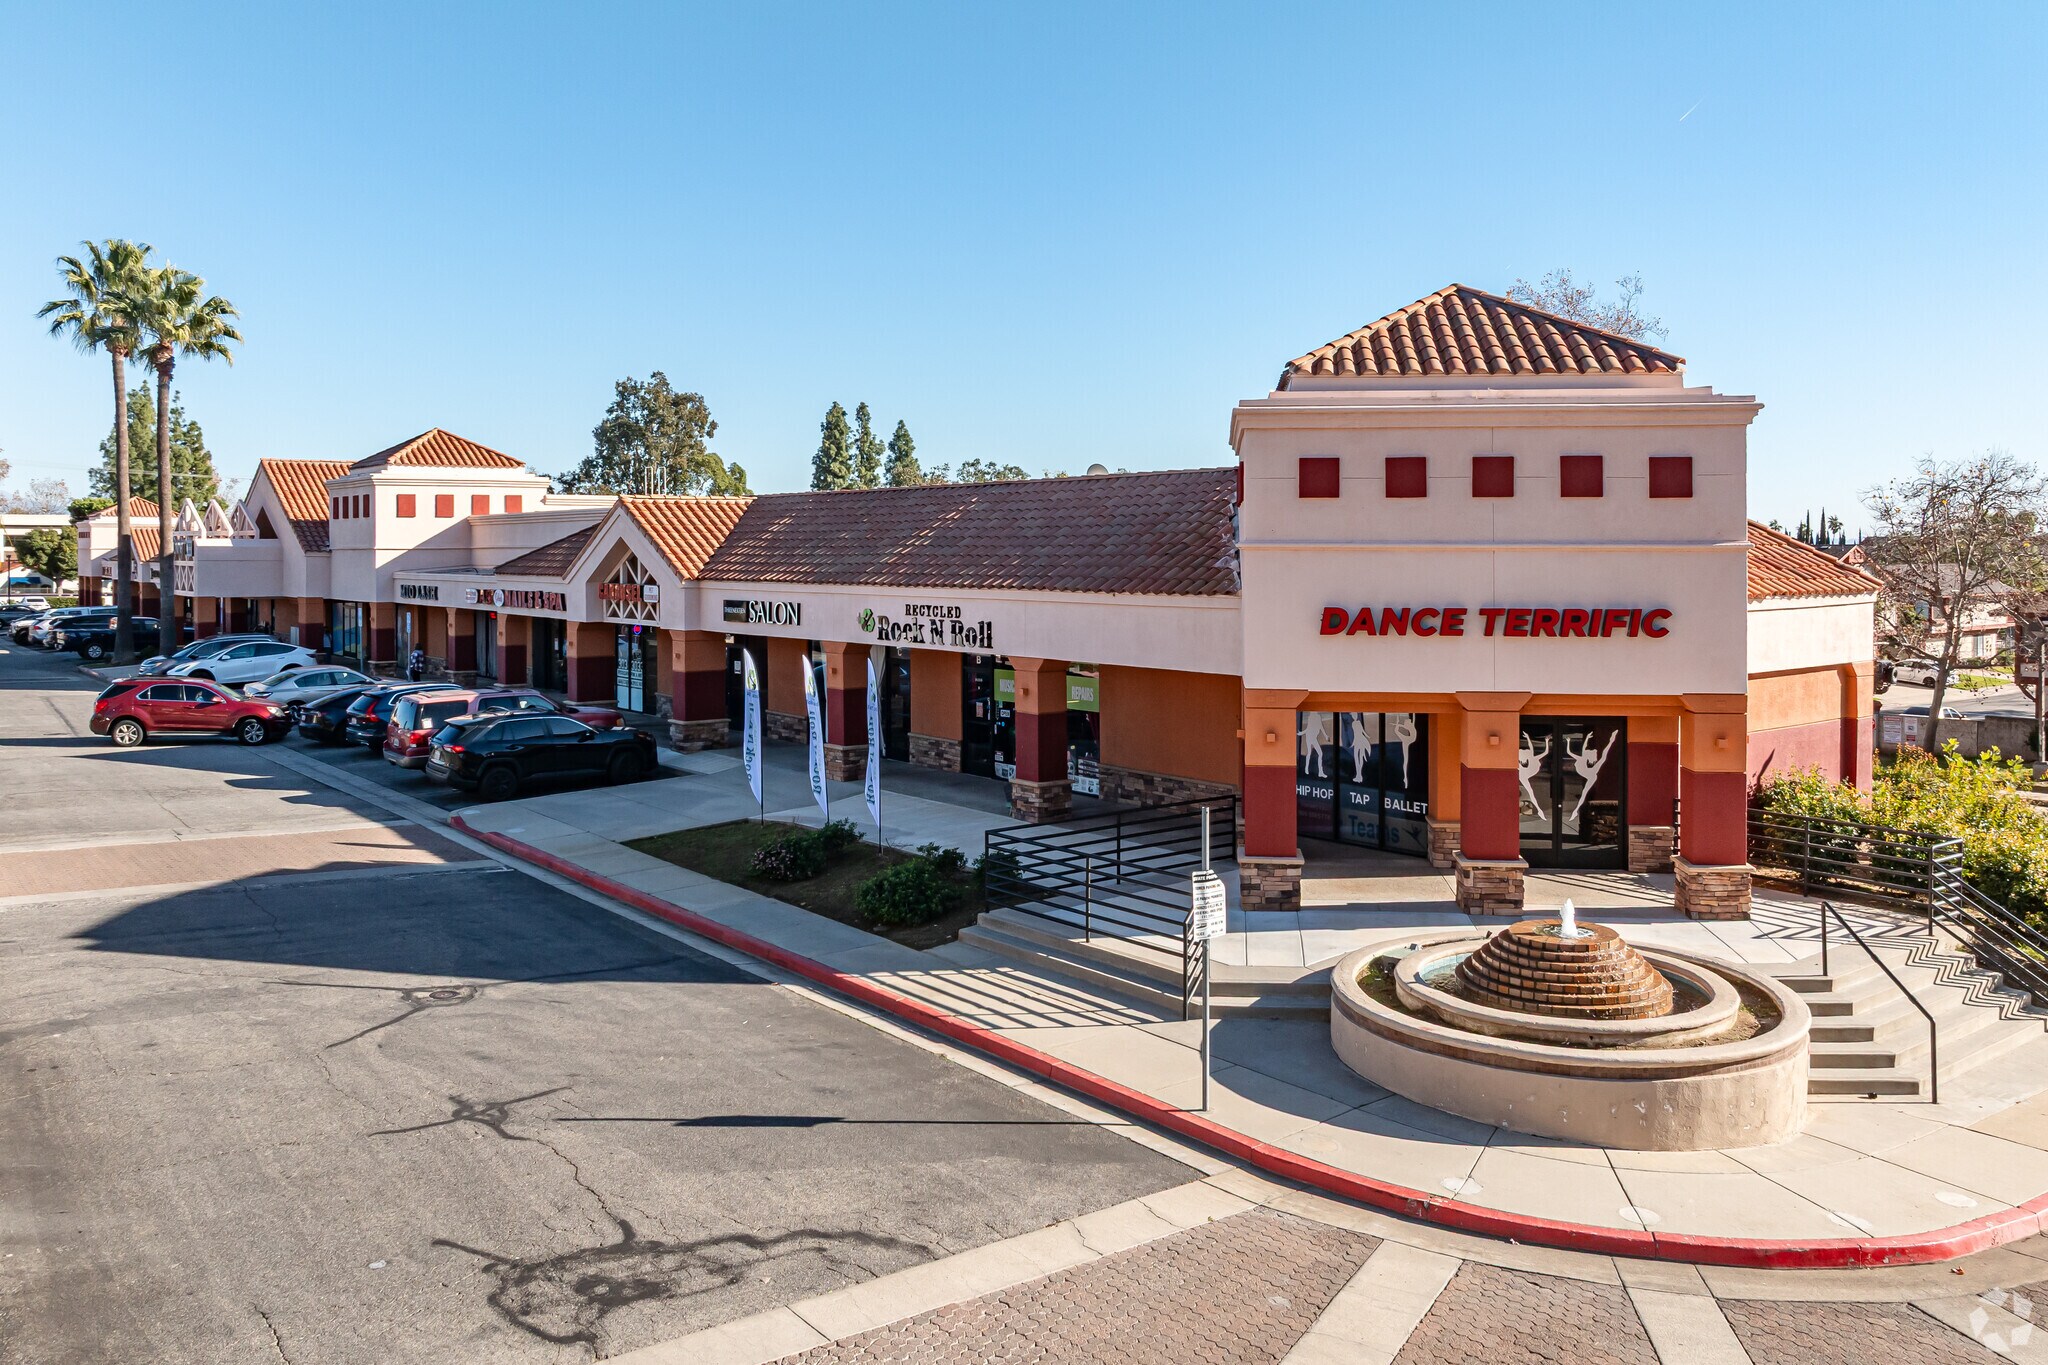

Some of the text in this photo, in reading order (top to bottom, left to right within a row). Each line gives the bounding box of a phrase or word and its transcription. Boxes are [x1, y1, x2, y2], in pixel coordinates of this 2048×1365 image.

[504, 590, 535, 608] NAILS
[543, 592, 564, 611] SPA
[748, 600, 800, 625] SALON
[905, 603, 961, 619] RECYCLED
[1320, 607, 1673, 638] DANCE TERRIFIC
[928, 618, 945, 646] N
[976, 655, 981, 664] B
[1071, 685, 1094, 702] REPAIRS
[1296, 784, 1334, 800] HIP HOP
[1349, 791, 1370, 805] TAP
[1384, 797, 1428, 815] BALLET
